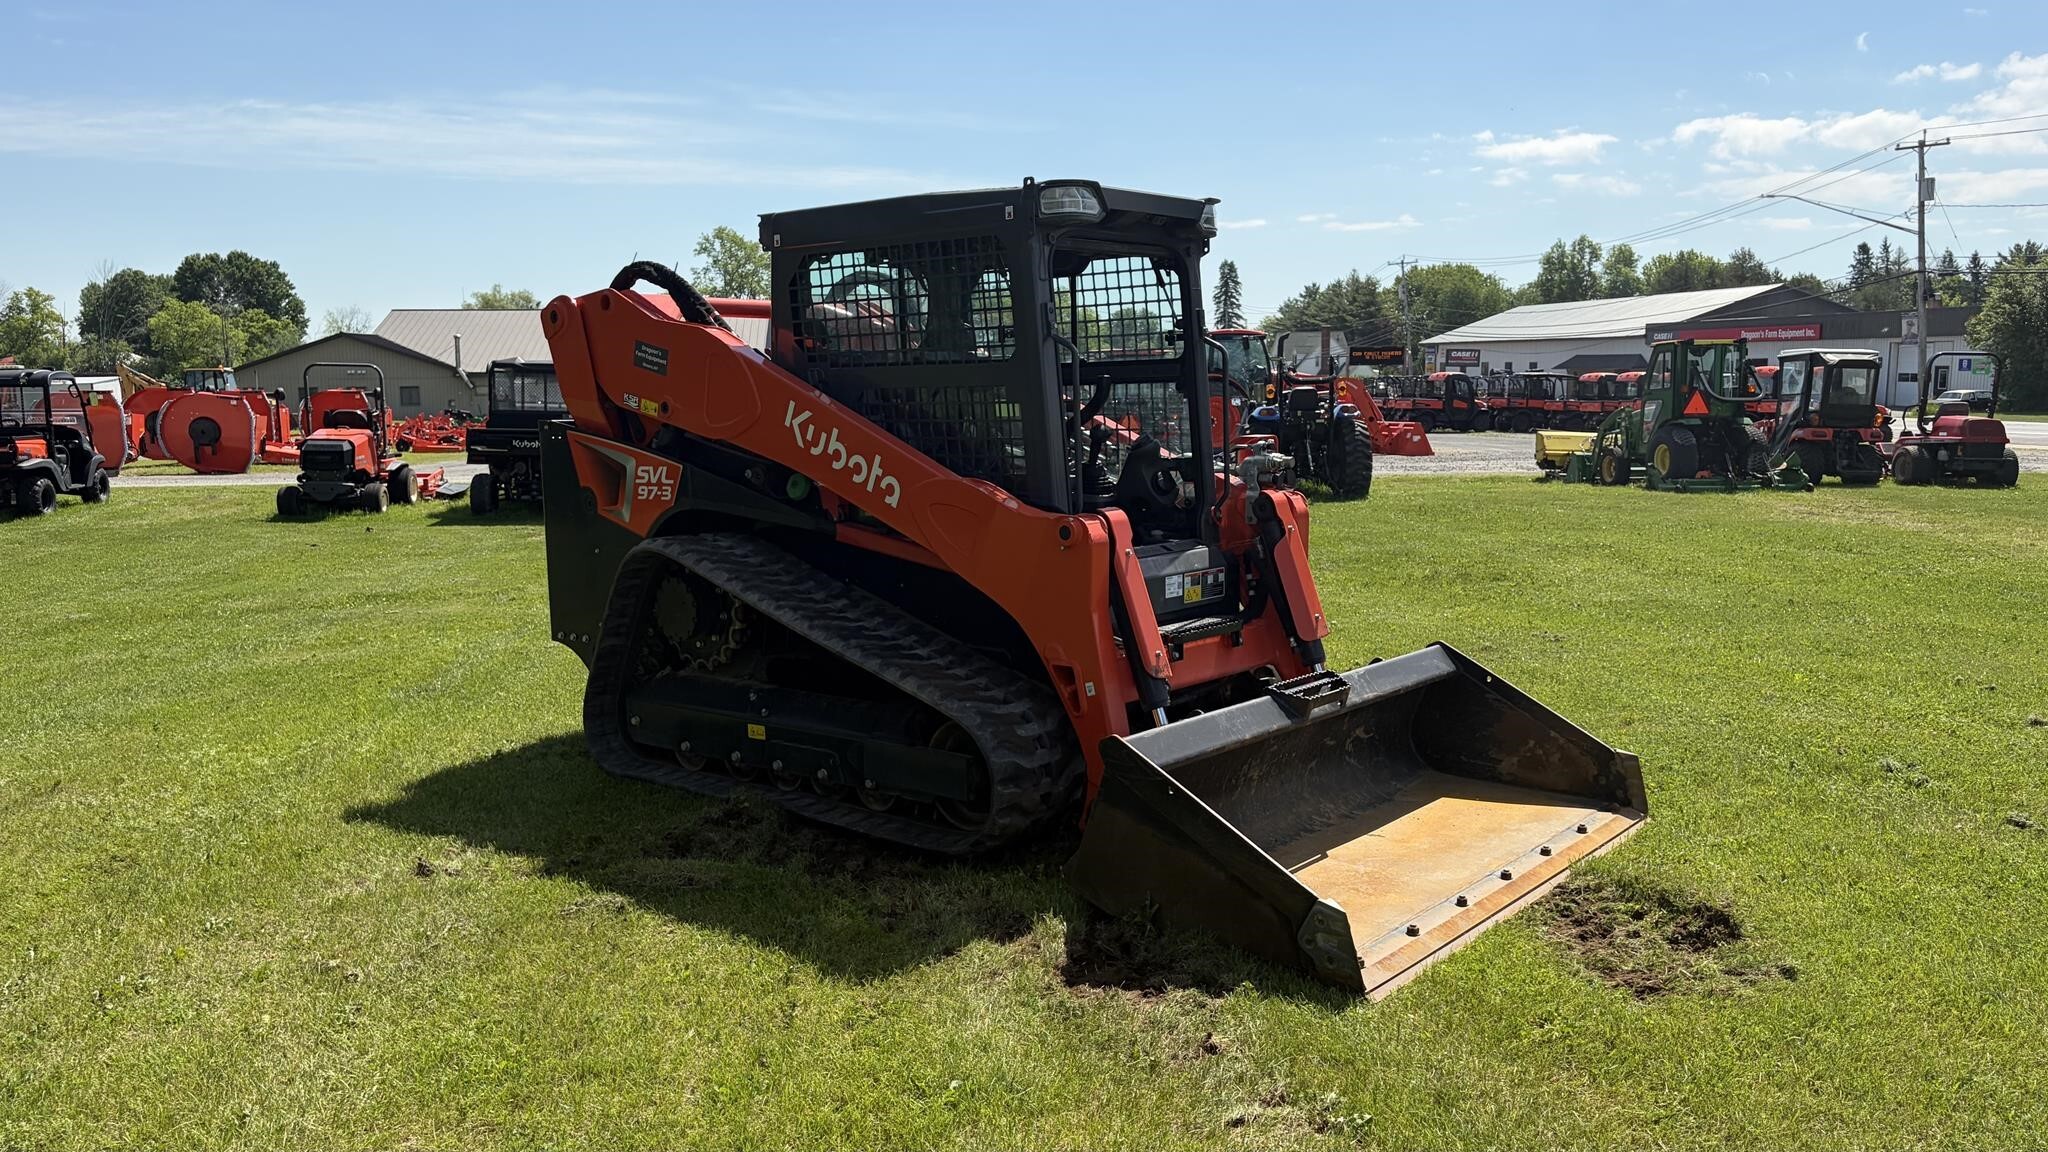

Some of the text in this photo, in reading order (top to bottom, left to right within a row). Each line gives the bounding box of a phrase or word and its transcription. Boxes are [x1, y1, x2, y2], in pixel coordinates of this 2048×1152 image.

[1740, 328, 1816, 340] Dragoon's Farm Equipment Inc.
[784, 400, 901, 509] Kubota
[635, 466, 674, 484] SVL
[637, 485, 672, 500] 97-3
